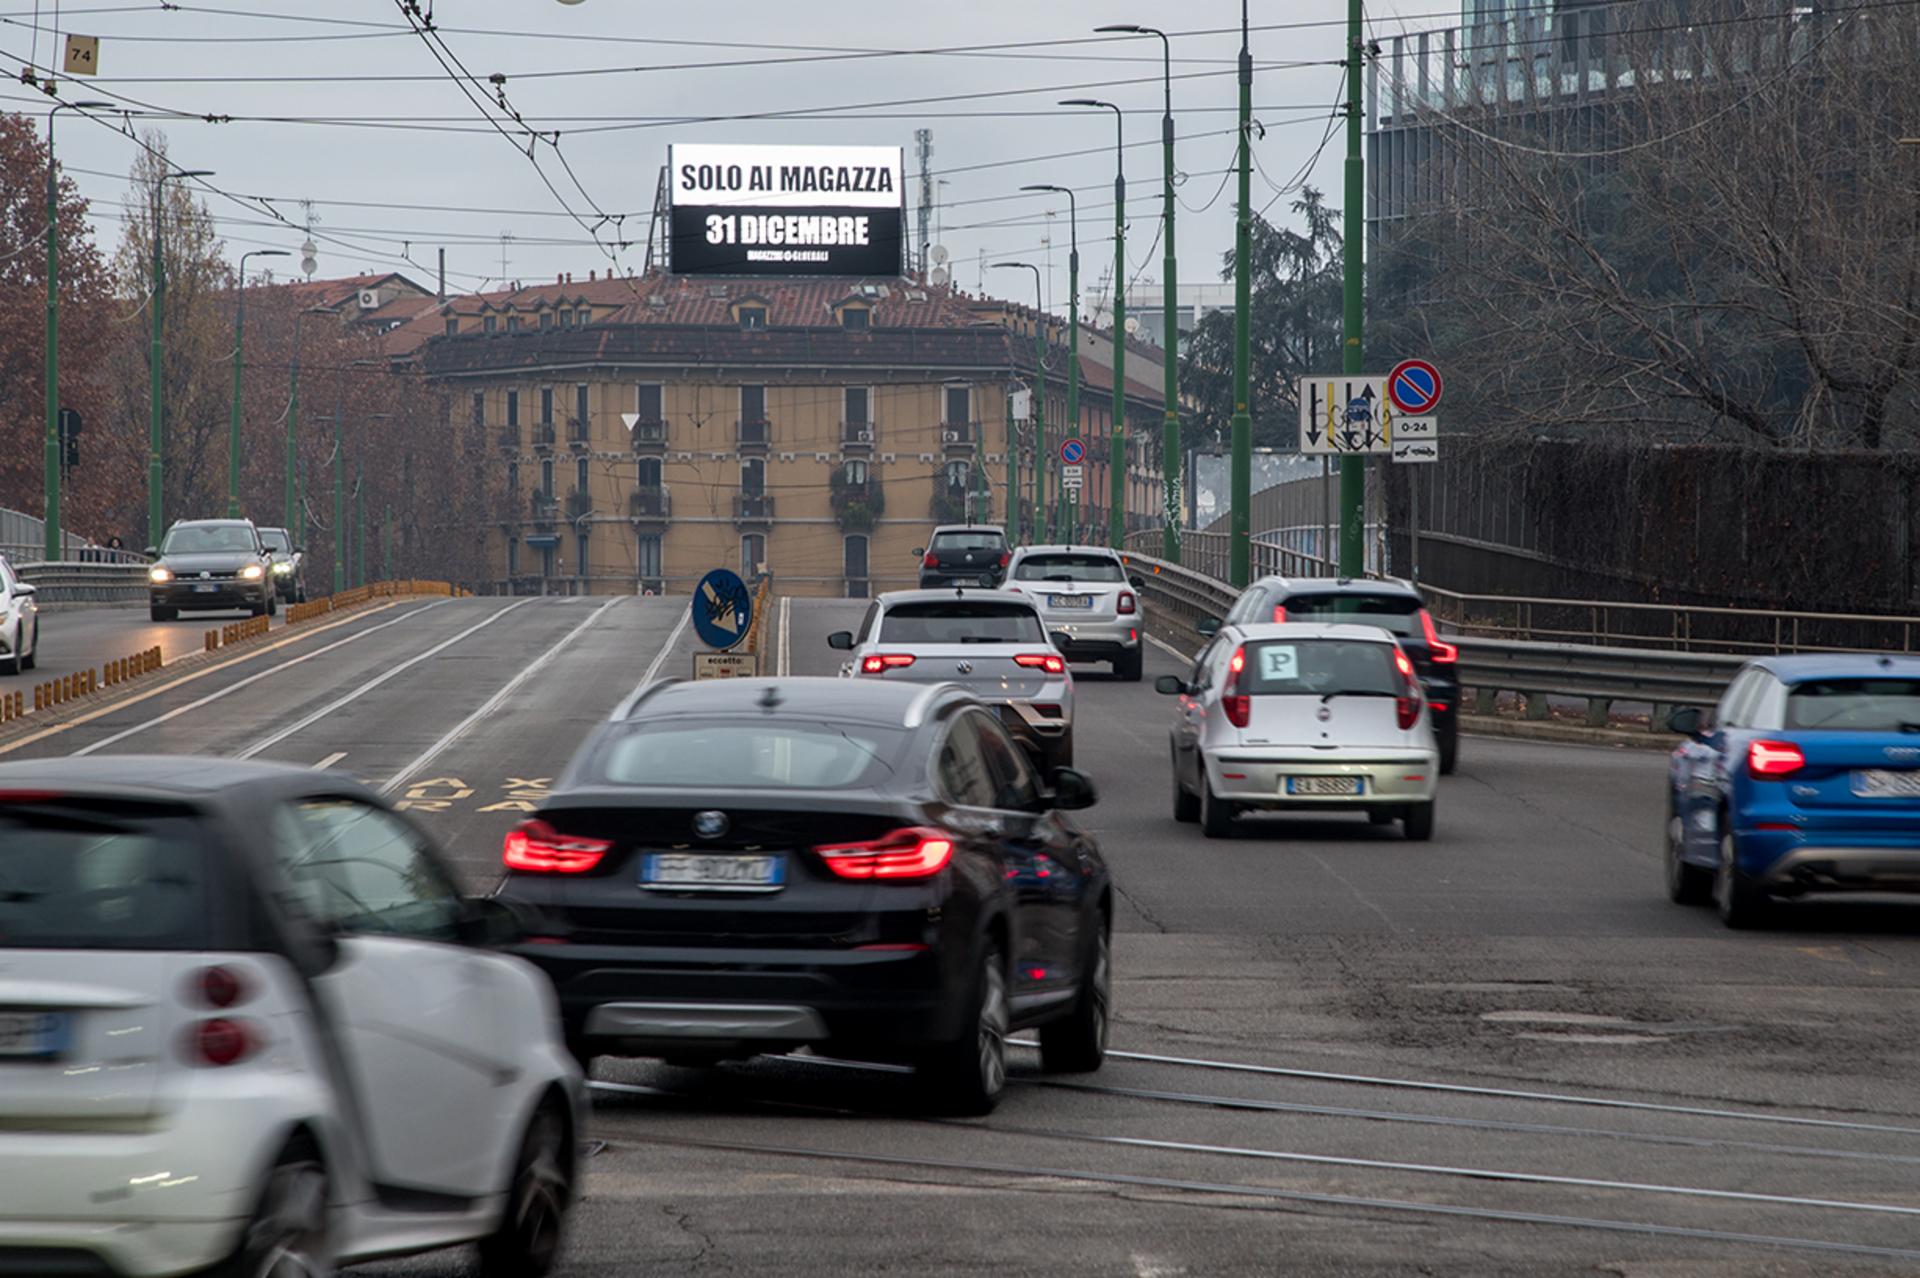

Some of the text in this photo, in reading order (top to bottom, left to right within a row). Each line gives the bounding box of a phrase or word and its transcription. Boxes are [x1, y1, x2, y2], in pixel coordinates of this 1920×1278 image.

[72, 48, 91, 62] 74
[681, 164, 893, 193] SOLO AI MAGAZZA
[706, 214, 869, 245] 31 DICEMBRE
[1401, 422, 1428, 432] 0-24
[708, 656, 742, 665] eccetto
[1268, 652, 1291, 673] P
